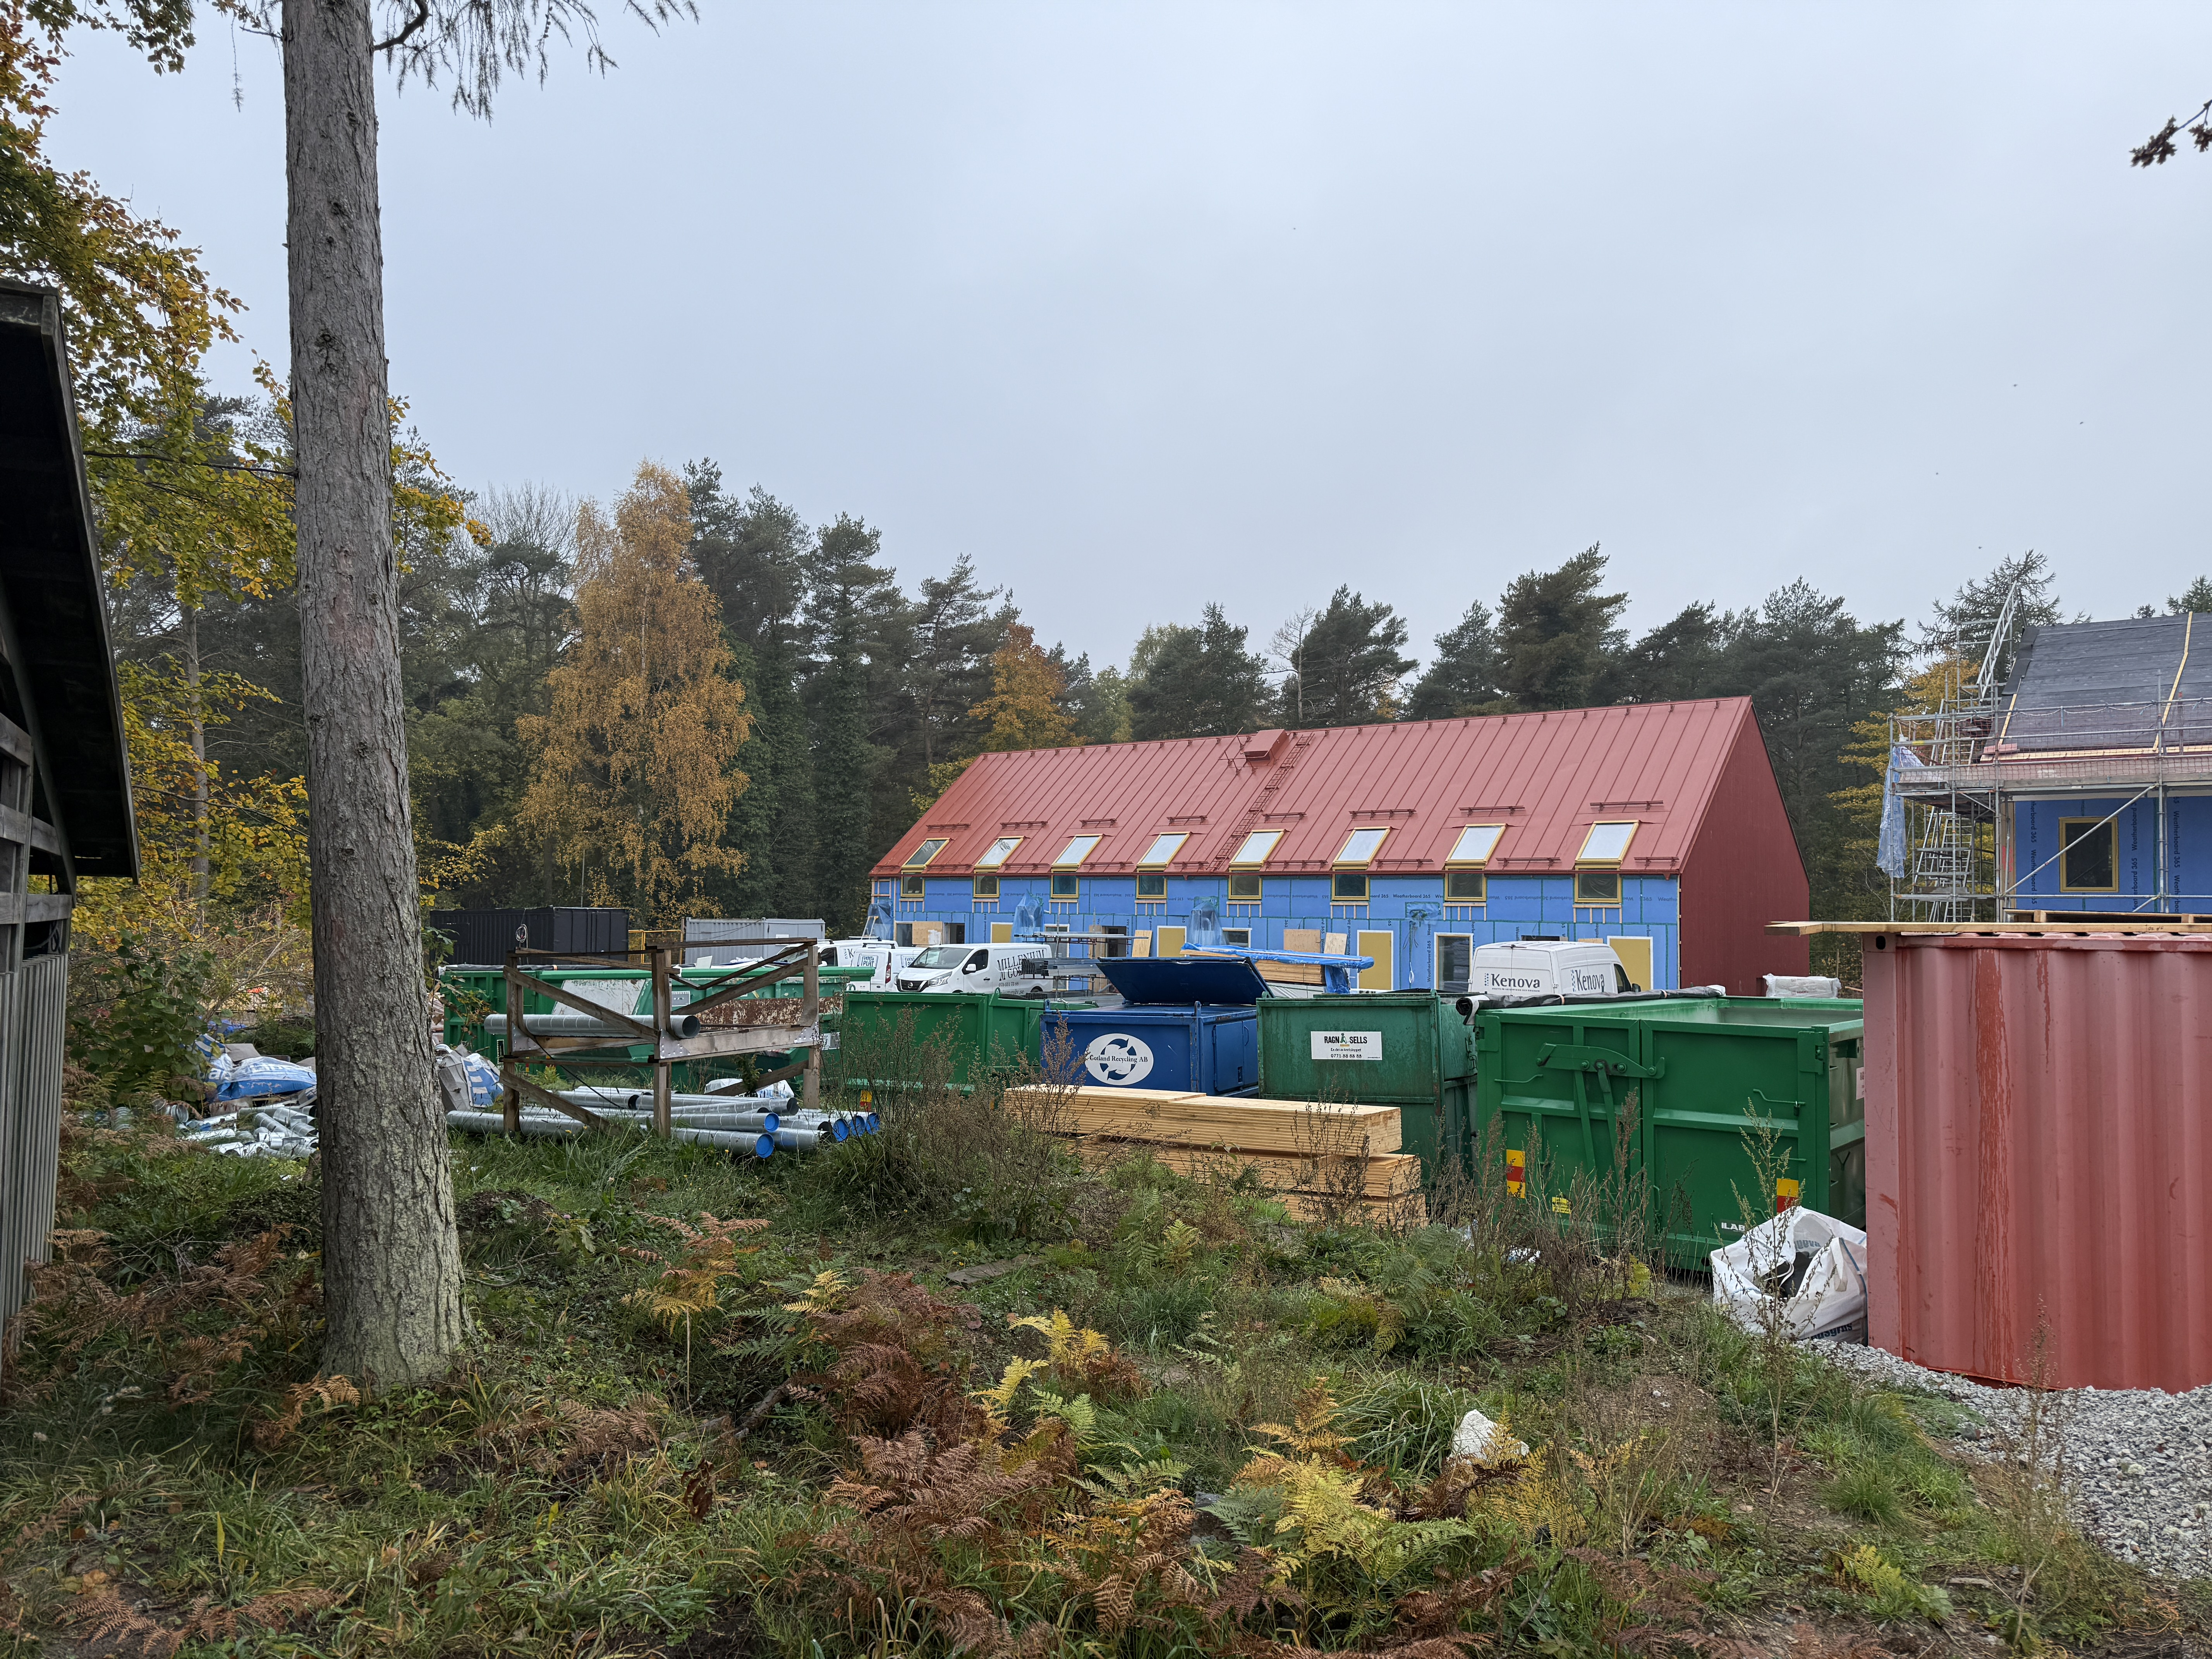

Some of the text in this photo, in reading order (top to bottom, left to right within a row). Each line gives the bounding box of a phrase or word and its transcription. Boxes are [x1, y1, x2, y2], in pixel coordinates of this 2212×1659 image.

[1491, 974, 1540, 988] Kenova
[1575, 969, 1604, 991] Kenova
[1112, 1056, 1138, 1064] Recycling
